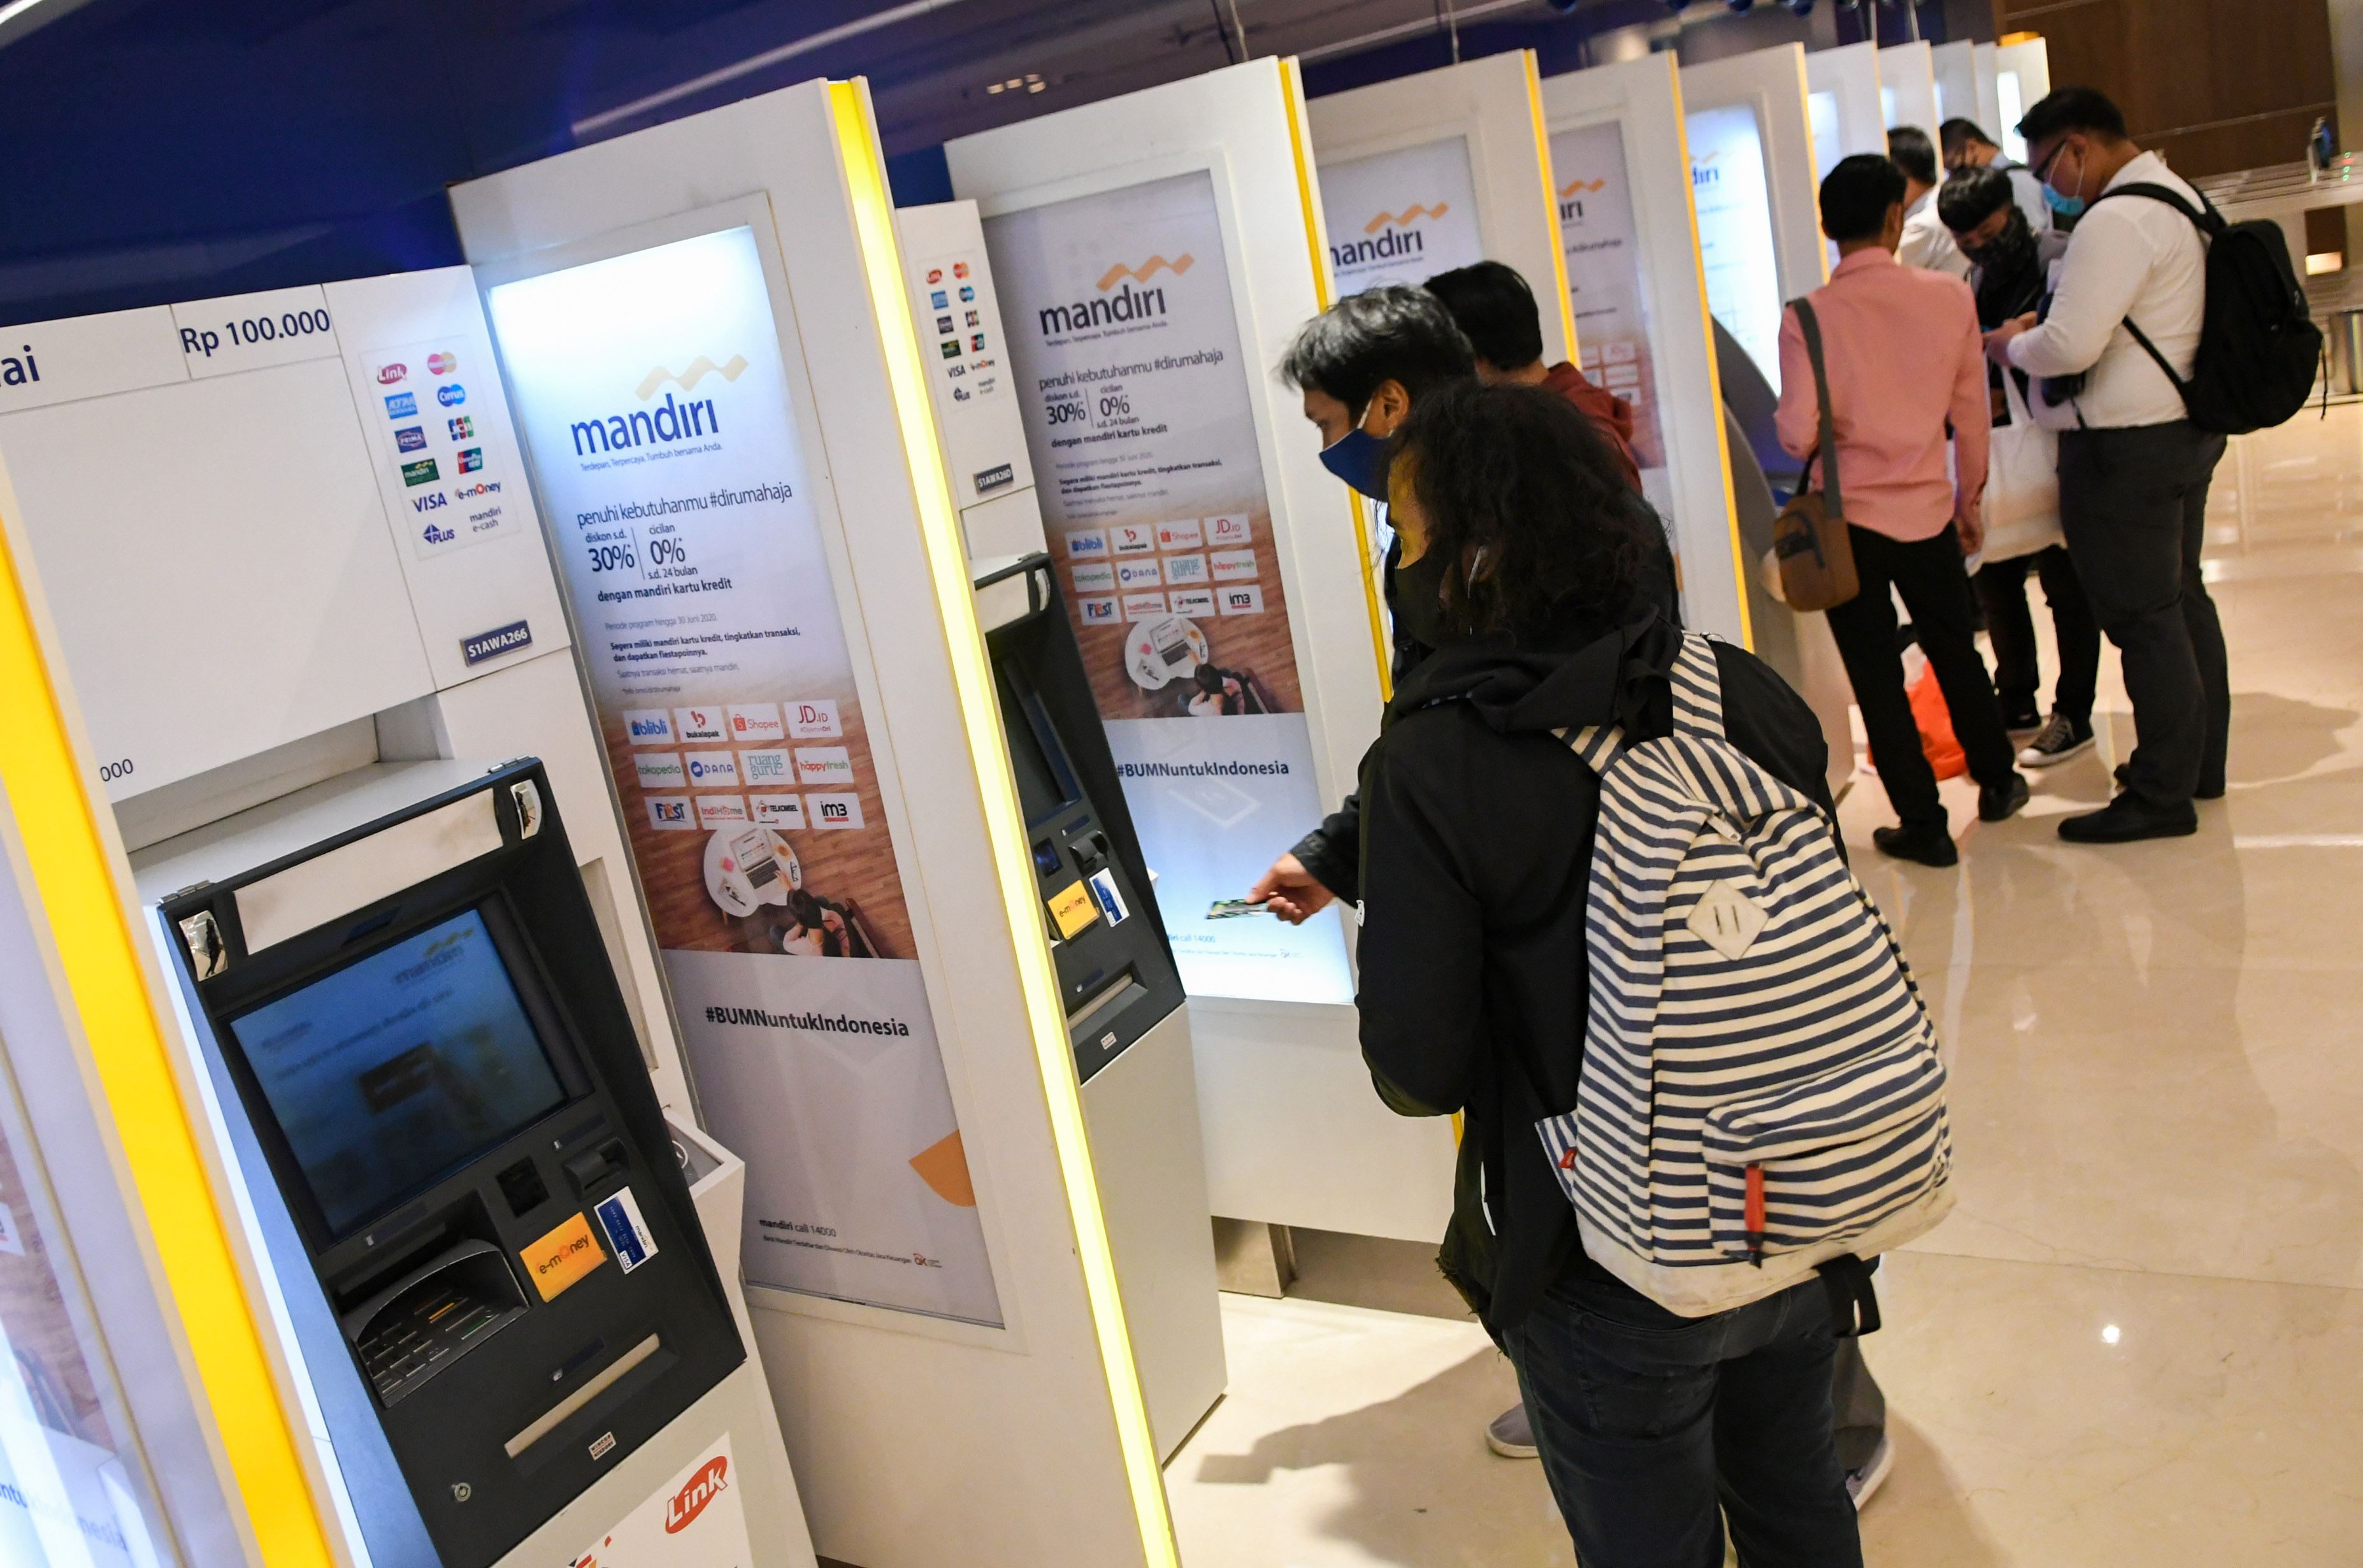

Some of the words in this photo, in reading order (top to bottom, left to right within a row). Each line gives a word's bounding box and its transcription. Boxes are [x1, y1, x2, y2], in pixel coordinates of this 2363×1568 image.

[1560, 201, 1583, 220] iri
[1039, 284, 1166, 335] mandiri
[180, 327, 219, 357] Rp
[226, 309, 330, 345] 100.000
[0, 345, 40, 387] ai
[378, 365, 408, 381] Link
[947, 365, 966, 378] VISA
[1038, 370, 1075, 391] penuhi
[1076, 363, 1152, 383] kebutuhanmu
[1154, 348, 1224, 370] #dirumahaja
[439, 389, 464, 402] Cirrus
[1100, 384, 1123, 394] cicilan
[571, 392, 719, 456] mandiri
[1119, 416, 1139, 426] bulan
[1052, 436, 1082, 448] dengan
[1084, 431, 1115, 443] mandiri
[1117, 428, 1140, 438] kartu
[1141, 424, 1168, 435] kredit
[646, 450, 673, 461] Tumbuh
[674, 447, 702, 457] bersama
[703, 442, 723, 451] Anda.
[412, 492, 448, 512] VISA
[577, 504, 620, 529] penuhi
[621, 496, 708, 521] kebutuhanmu
[710, 481, 793, 508] #dirumahaja
[470, 507, 501, 522] mandiri
[473, 518, 498, 532] e-cash
[649, 523, 675, 535] cicilan
[433, 529, 455, 543] PLUS
[585, 531, 612, 543] diskon
[613, 528, 626, 540] s.d.
[648, 570, 661, 580] s.d.
[663, 568, 673, 577] 24
[674, 565, 698, 577] bulan
[598, 589, 633, 603] dengan
[635, 584, 672, 598] mandiri
[673, 582, 700, 594] kartu
[701, 577, 733, 591] kredit
[605, 621, 628, 630] Periode
[629, 619, 654, 629] program
[654, 617, 677, 628] hingga
[677, 615, 686, 624] 30
[687, 614, 700, 623] Juni
[701, 613, 718, 622] 2020.
[468, 627, 528, 658] S1AWA266
[610, 642, 633, 651] Segera
[634, 639, 652, 649] miliki
[653, 637, 680, 647] mandiri
[680, 636, 700, 645] kartu
[700, 634, 724, 643] kredit,
[724, 630, 764, 642] tingkatkan
[764, 626, 801, 638] transaksi,
[614, 653, 626, 662] dan
[627, 651, 658, 662] dapatkan
[659, 648, 708, 659] fiestapoinnya.
[798, 705, 828, 724] JD.ID
[638, 718, 668, 736] blibli
[747, 718, 779, 731] Shopee
[686, 730, 720, 738] bukalapak
[705, 763, 734, 773] DANA
[747, 754, 782, 768] ruang
[1117, 760, 1289, 777] #BUMNuntukIndonesia
[100, 758, 134, 782] 000
[638, 765, 681, 775] tokopedia
[701, 805, 743, 816] IndiHome
[820, 800, 847, 817] im3
[706, 1006, 910, 1037] #BUMNuntukIndonesia
[759, 1218, 793, 1232] mandiri
[794, 1222, 809, 1234] call
[810, 1225, 837, 1237] 14000
[635, 1225, 648, 1248] mandiri
[621, 1252, 631, 1267] VISA
[667, 1465, 728, 1529] Link
